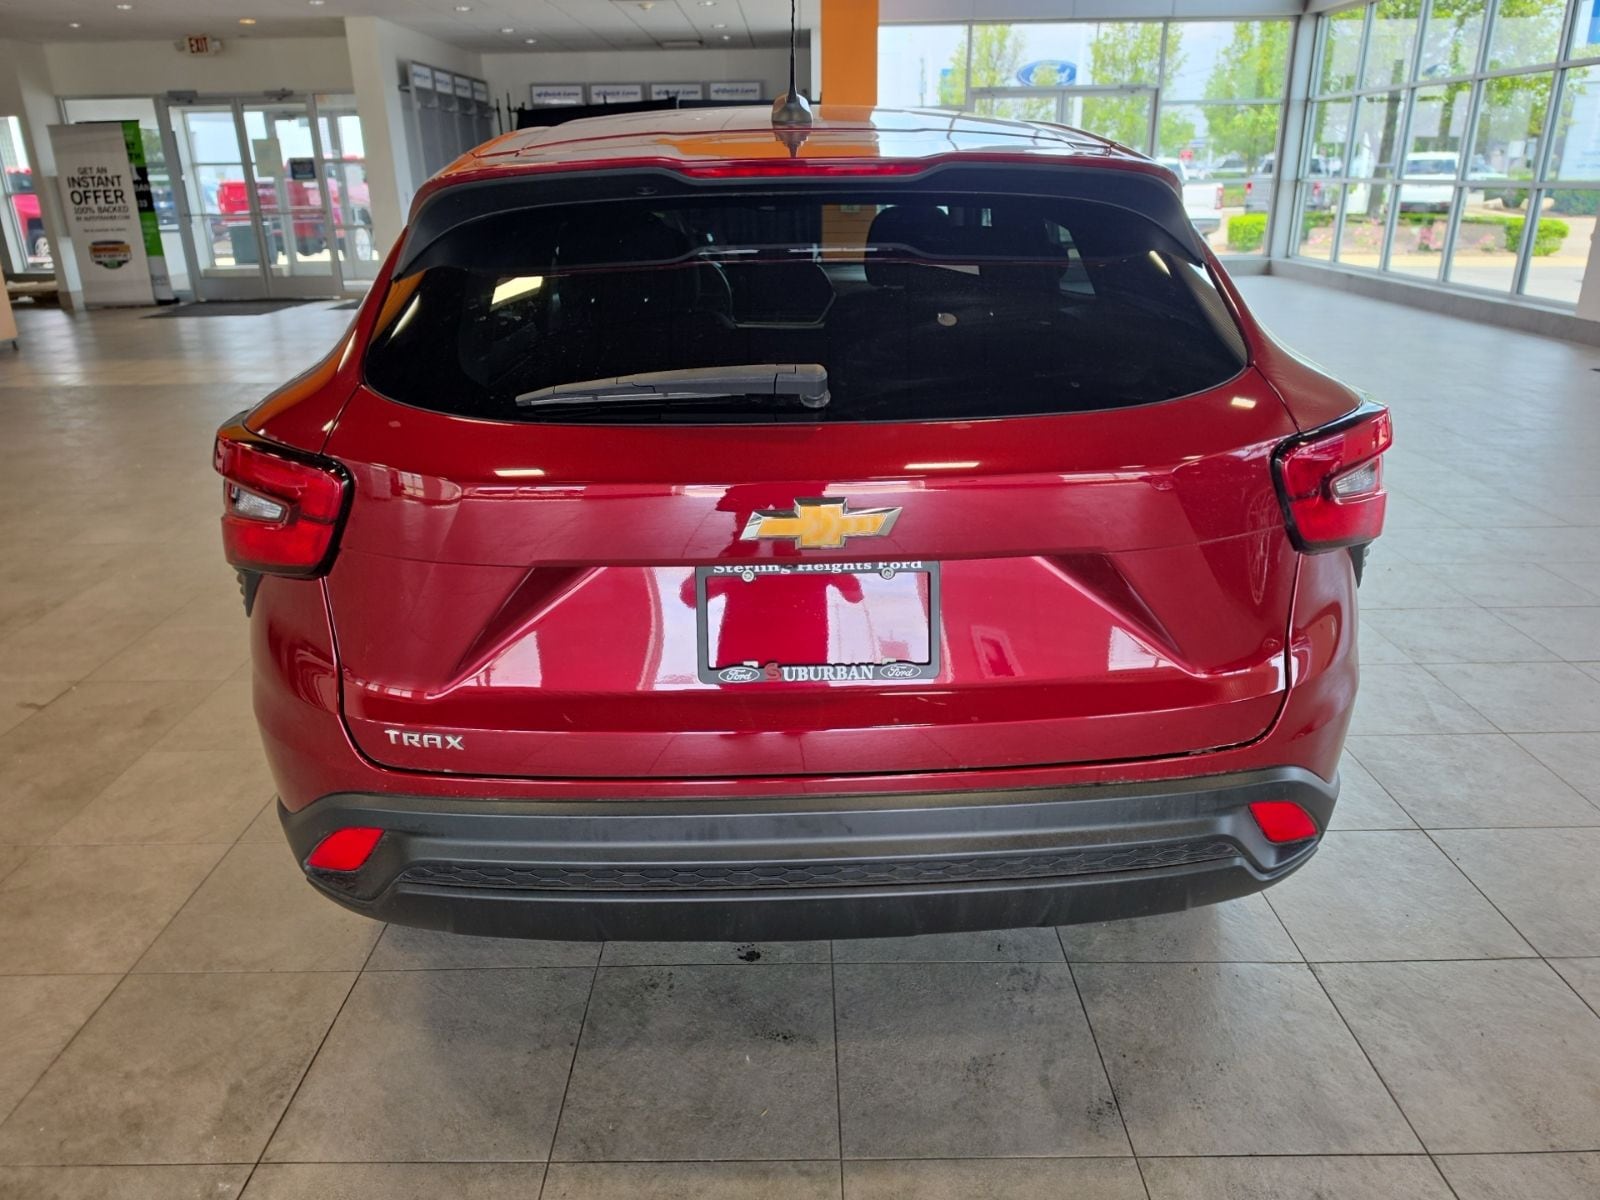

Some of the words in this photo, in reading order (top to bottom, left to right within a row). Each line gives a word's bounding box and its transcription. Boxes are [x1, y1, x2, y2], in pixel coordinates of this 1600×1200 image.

[189, 37, 208, 53] EXIT
[77, 167, 93, 175] GET
[96, 166, 107, 174] AN
[67, 175, 121, 188] INSTANT
[70, 189, 126, 205] OFFER
[74, 206, 95, 214] 100%
[97, 205, 129, 214] BACKED
[796, 561, 872, 573] Heights
[726, 669, 752, 681] Ford
[764, 663, 874, 681] SUBURBAN
[887, 665, 913, 678] Ford
[384, 729, 465, 750] TRAX
